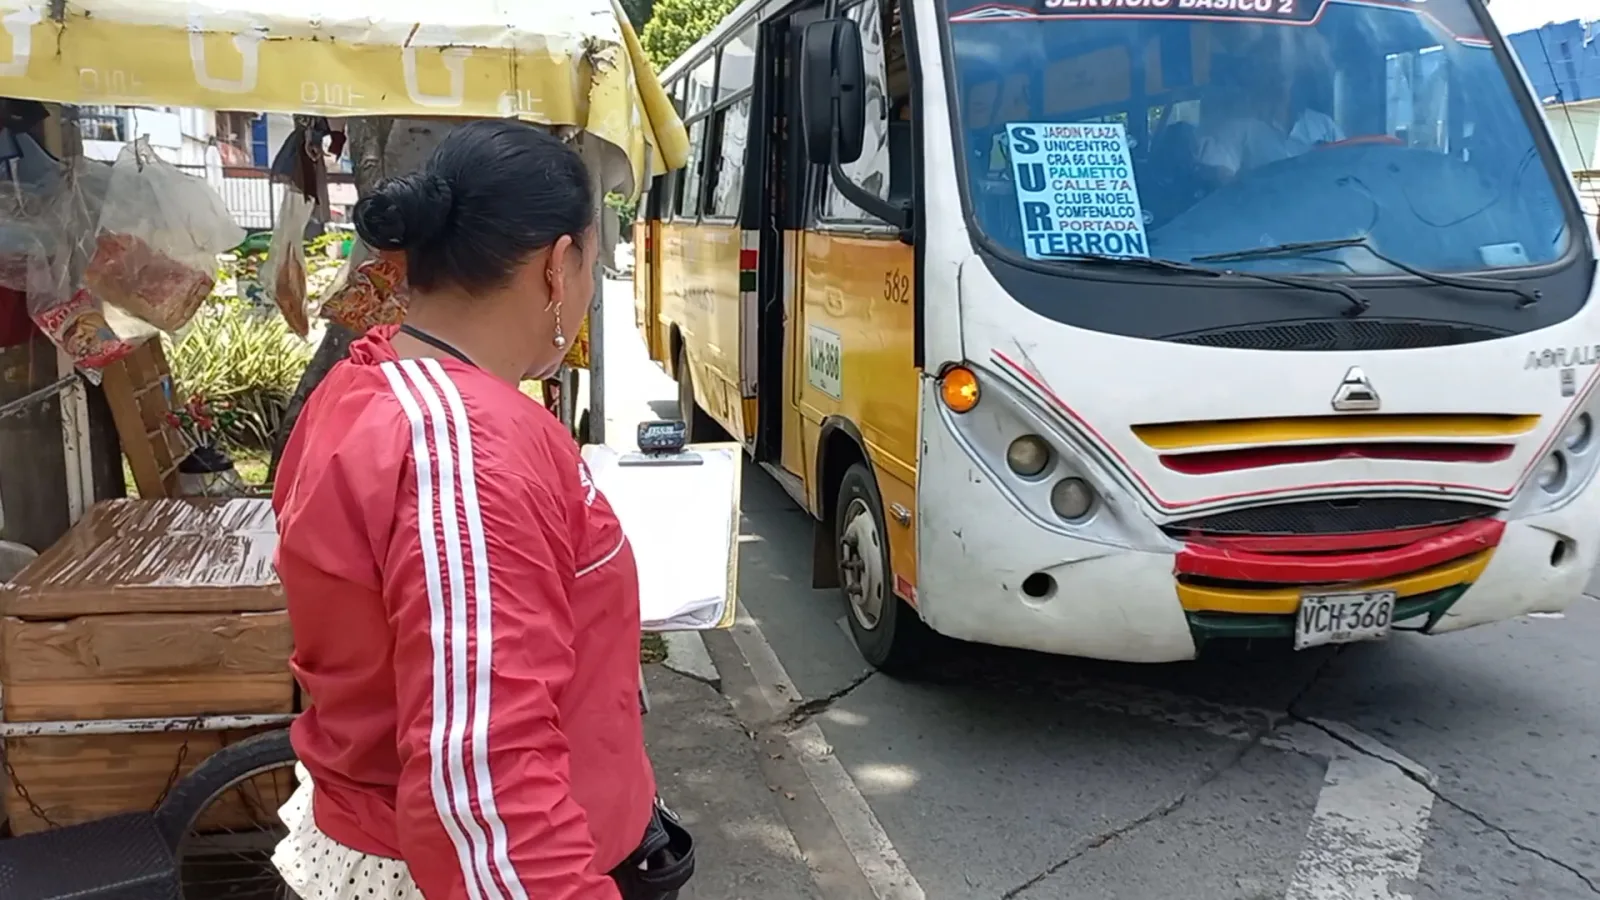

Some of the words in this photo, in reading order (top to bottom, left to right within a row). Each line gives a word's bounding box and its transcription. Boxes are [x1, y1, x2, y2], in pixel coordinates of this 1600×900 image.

[1277, 0, 1293, 13] 2
[1043, 127, 1081, 139] JARDIN
[1084, 127, 1120, 139] PLAZA
[1044, 140, 1120, 152] UNICENTRO
[1047, 154, 1071, 166] CRA
[1087, 154, 1110, 166] CLL
[1050, 167, 1128, 179] PALMETTO
[1052, 180, 1106, 191] CALLE
[1110, 180, 1132, 191] 7A
[1054, 193, 1092, 205] CLUB
[1096, 193, 1134, 205] NOEL
[1056, 206, 1135, 219] COMFENALCO
[1059, 220, 1139, 232] PORTADA
[1028, 232, 1145, 254] TERRON
[883, 268, 910, 304] 582
